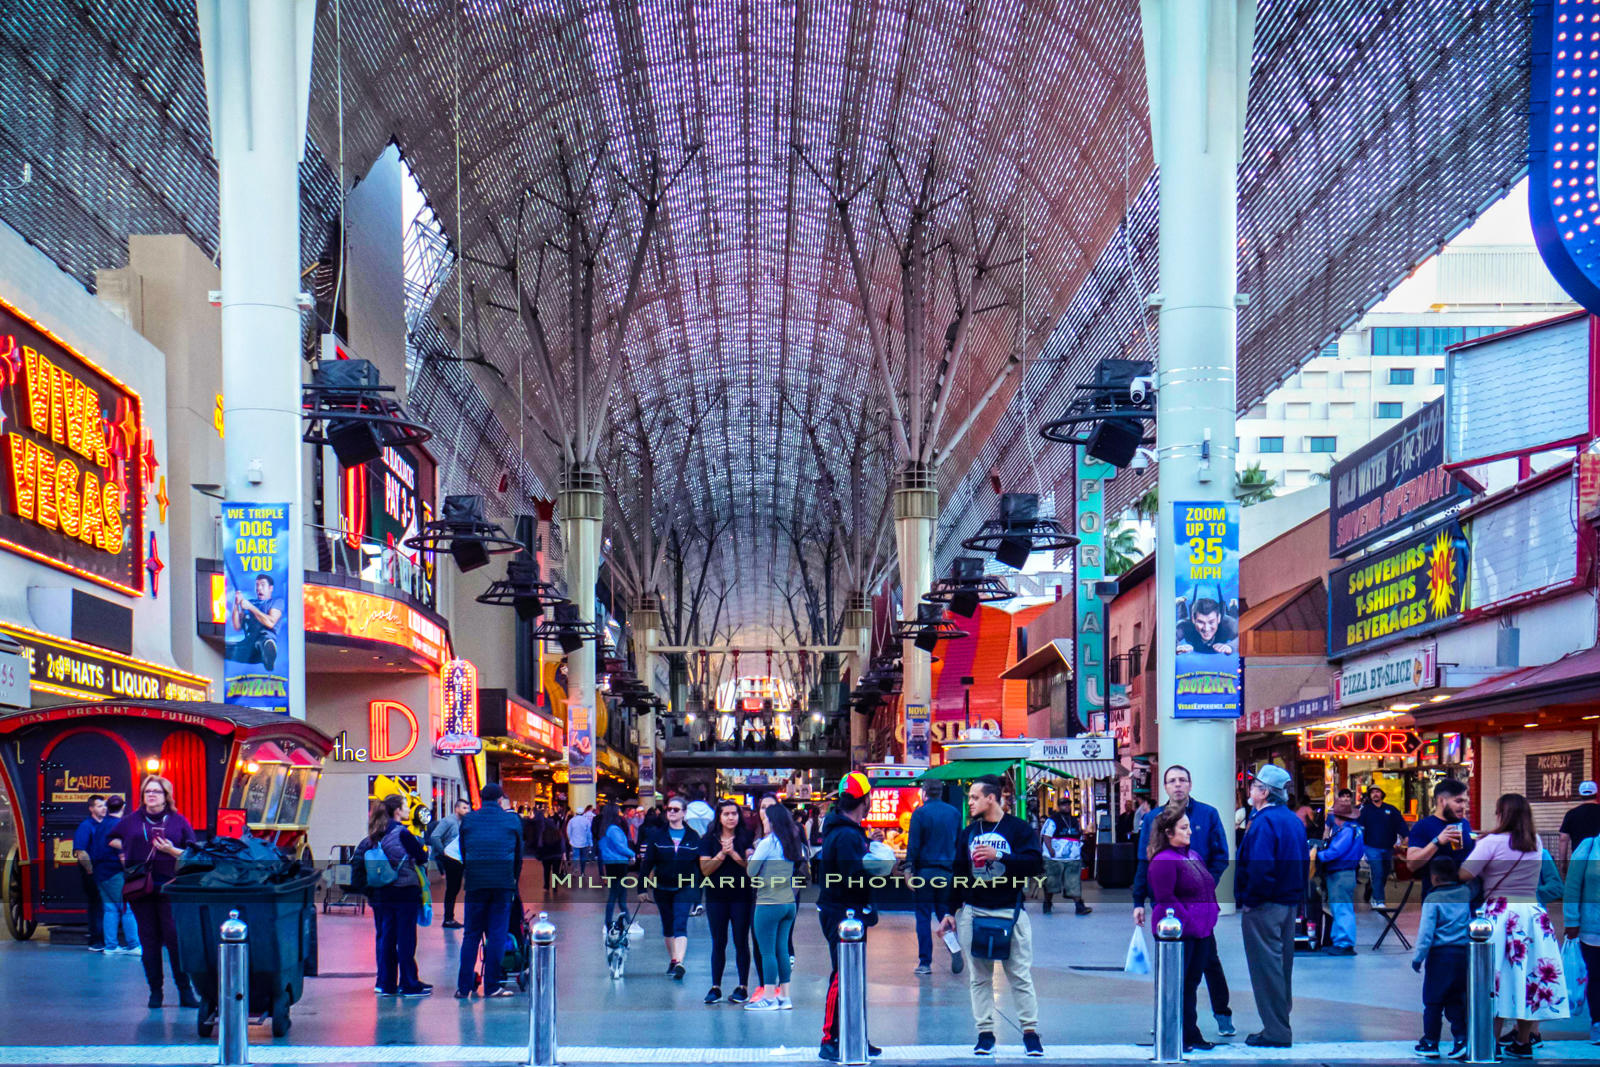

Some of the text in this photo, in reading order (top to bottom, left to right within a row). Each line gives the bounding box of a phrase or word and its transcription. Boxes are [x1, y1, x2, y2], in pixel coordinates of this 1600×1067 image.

[22, 345, 109, 468] VIVA
[1337, 469, 1357, 509] COLD
[1358, 450, 1389, 498] WATER
[1392, 446, 1399, 478] 2
[1416, 403, 1441, 468] $1.00
[9, 432, 123, 555] VEGAS
[384, 471, 401, 520] PAY
[1336, 464, 1452, 548] SOUVENIR SUPERMART
[228, 509, 283, 519] WE TRIPLE
[1185, 508, 1226, 521] ZOOM
[240, 521, 272, 536] DOG
[1186, 523, 1226, 536] UP TO
[236, 539, 277, 554] DARE
[1189, 538, 1223, 565] 35
[241, 556, 272, 571] YOU
[1190, 566, 1222, 579] MPH
[1348, 542, 1426, 595] SOUVENIRS
[1356, 575, 1416, 617] T-SHIRTS
[1347, 599, 1427, 646] BEVERAGES
[71, 659, 105, 689] HATS
[111, 668, 159, 699] LIQUOR
[1343, 671, 1368, 696] PIZZA
[453, 667, 463, 735] AMERICAN
[20, 713, 51, 725] PAST
[67, 705, 130, 716] PRESENT
[161, 709, 207, 726] FUTURE
[333, 699, 419, 763] the D
[1309, 730, 1408, 753] LIQUOR
[1043, 745, 1069, 755] POKER
[1542, 772, 1573, 798] PIZZA
[864, 813, 898, 821] RIEND.
[870, 799, 899, 812] EST
